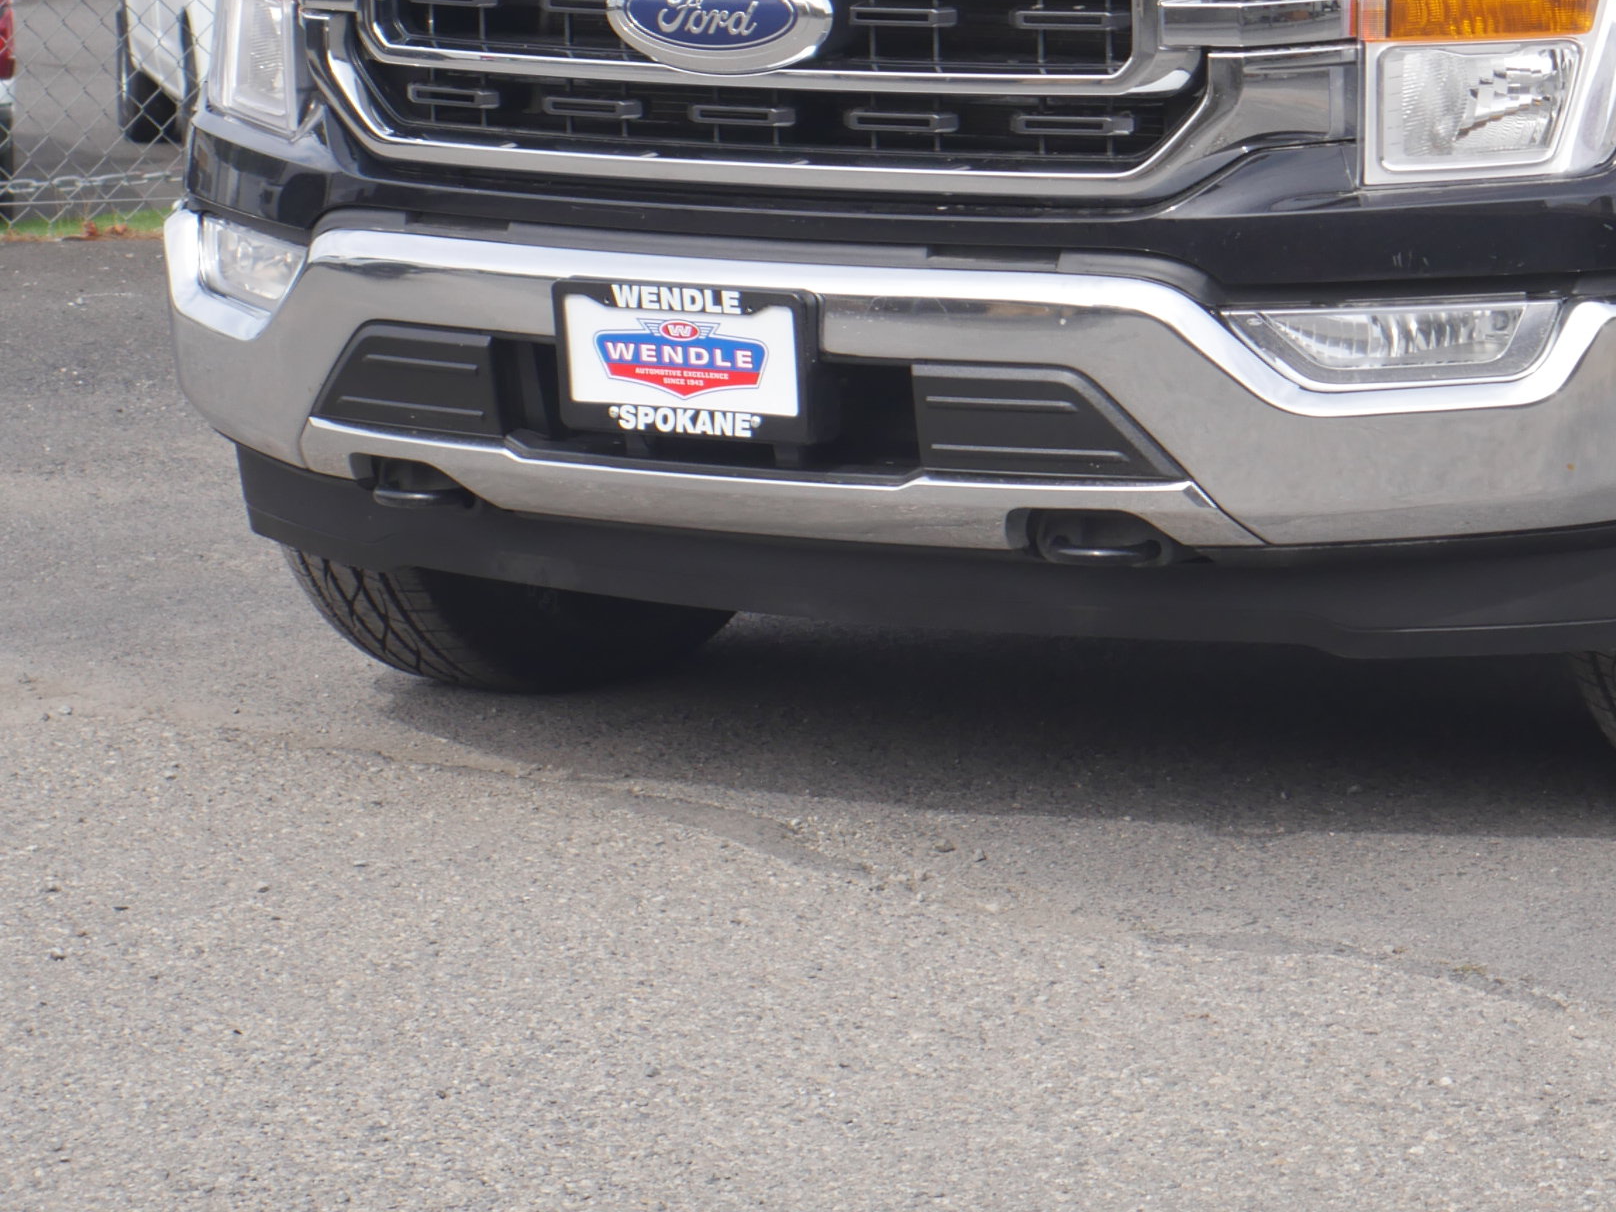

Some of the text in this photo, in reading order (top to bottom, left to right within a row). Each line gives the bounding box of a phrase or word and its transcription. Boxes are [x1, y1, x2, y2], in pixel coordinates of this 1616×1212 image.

[610, 283, 742, 315] WENDLE
[605, 341, 753, 369] WENDLE
[635, 367, 729, 380] AUTOMOTIVE EXCELLENCE
[663, 377, 685, 386] SINCE
[618, 404, 753, 437] SPOKANE
